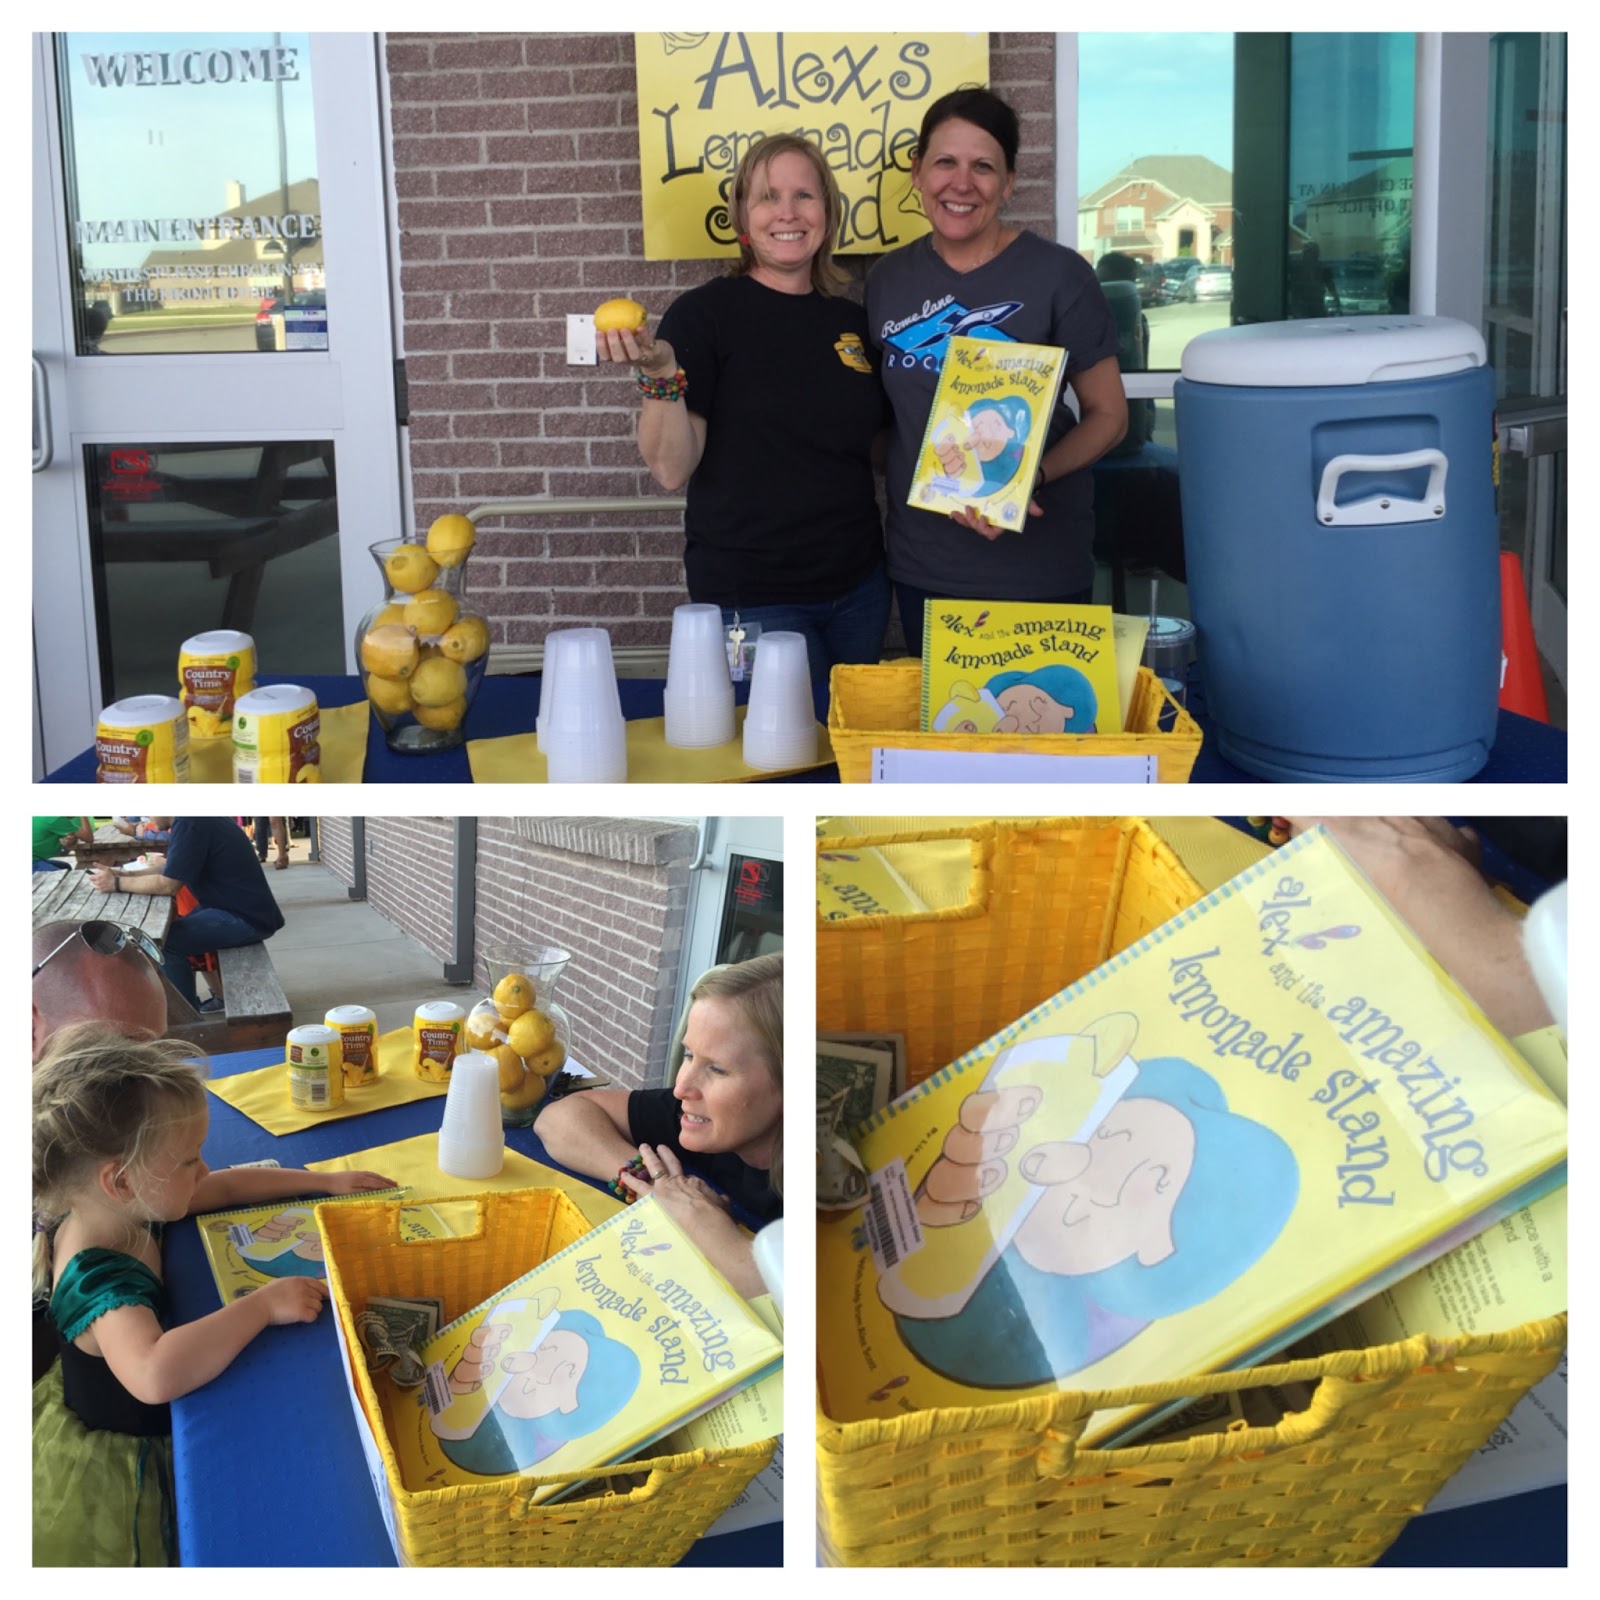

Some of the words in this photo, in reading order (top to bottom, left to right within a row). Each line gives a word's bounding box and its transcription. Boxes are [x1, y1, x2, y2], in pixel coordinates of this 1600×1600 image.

[80, 46, 299, 87] WELCOME
[652, 100, 919, 184] Lemnade
[76, 219, 158, 243] MAIN
[159, 213, 317, 242] ENTRANCE
[123, 287, 156, 302] THE
[921, 294, 955, 318] Lane
[996, 358, 1054, 379] amazing
[950, 375, 1004, 395] lemonade
[1009, 371, 1045, 396] stand
[940, 613, 974, 638] alex
[1013, 618, 1106, 642] amazing
[944, 642, 1034, 669] lemonade
[1040, 634, 1099, 664] stand
[185, 669, 231, 681] Country
[191, 678, 222, 688] Time
[101, 753, 131, 765] Time
[1259, 875, 1312, 957] alex
[1268, 962, 1304, 991] and
[1296, 981, 1326, 1009] the
[344, 1042, 366, 1050] Time
[422, 1030, 455, 1041] Country
[1168, 946, 1312, 1082] lemonade
[1308, 1068, 1395, 1209] stand
[1326, 996, 1488, 1183] amazing
[620, 1218, 647, 1259] alex
[625, 1261, 643, 1277] and
[576, 1253, 648, 1322] lemonade
[647, 1315, 689, 1385] stand
[654, 1278, 735, 1372] amazing
